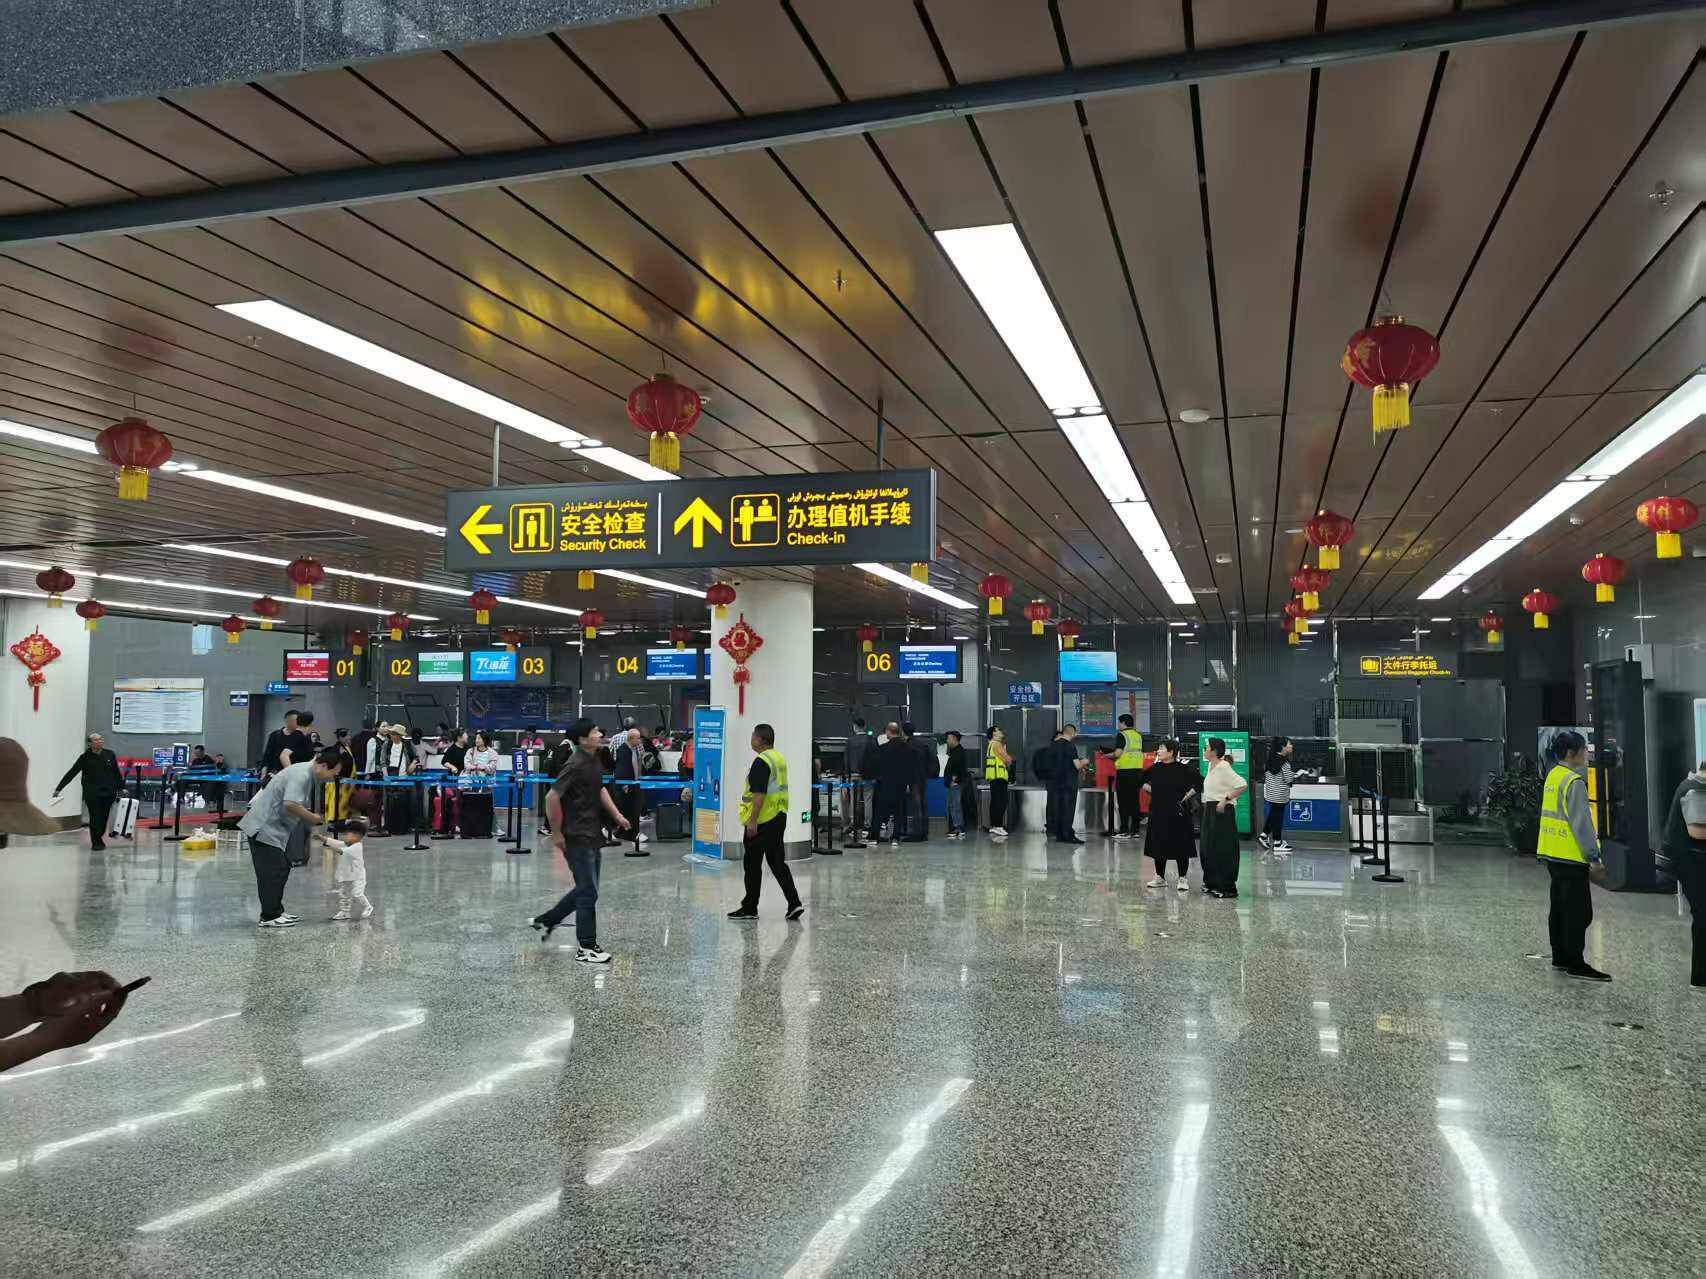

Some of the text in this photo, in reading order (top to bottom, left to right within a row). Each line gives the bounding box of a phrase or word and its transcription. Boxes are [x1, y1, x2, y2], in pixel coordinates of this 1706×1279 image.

[561, 511, 646, 536] 安全检查
[787, 502, 911, 530] 办理值机手续
[559, 537, 647, 553] Security Check
[787, 531, 846, 546] Check-in
[336, 659, 354, 677] 01
[390, 658, 412, 676] 02
[522, 657, 545, 675] 03
[616, 656, 639, 674] 04
[866, 653, 892, 672] 06
[1383, 660, 1438, 670] 大件行李托运
